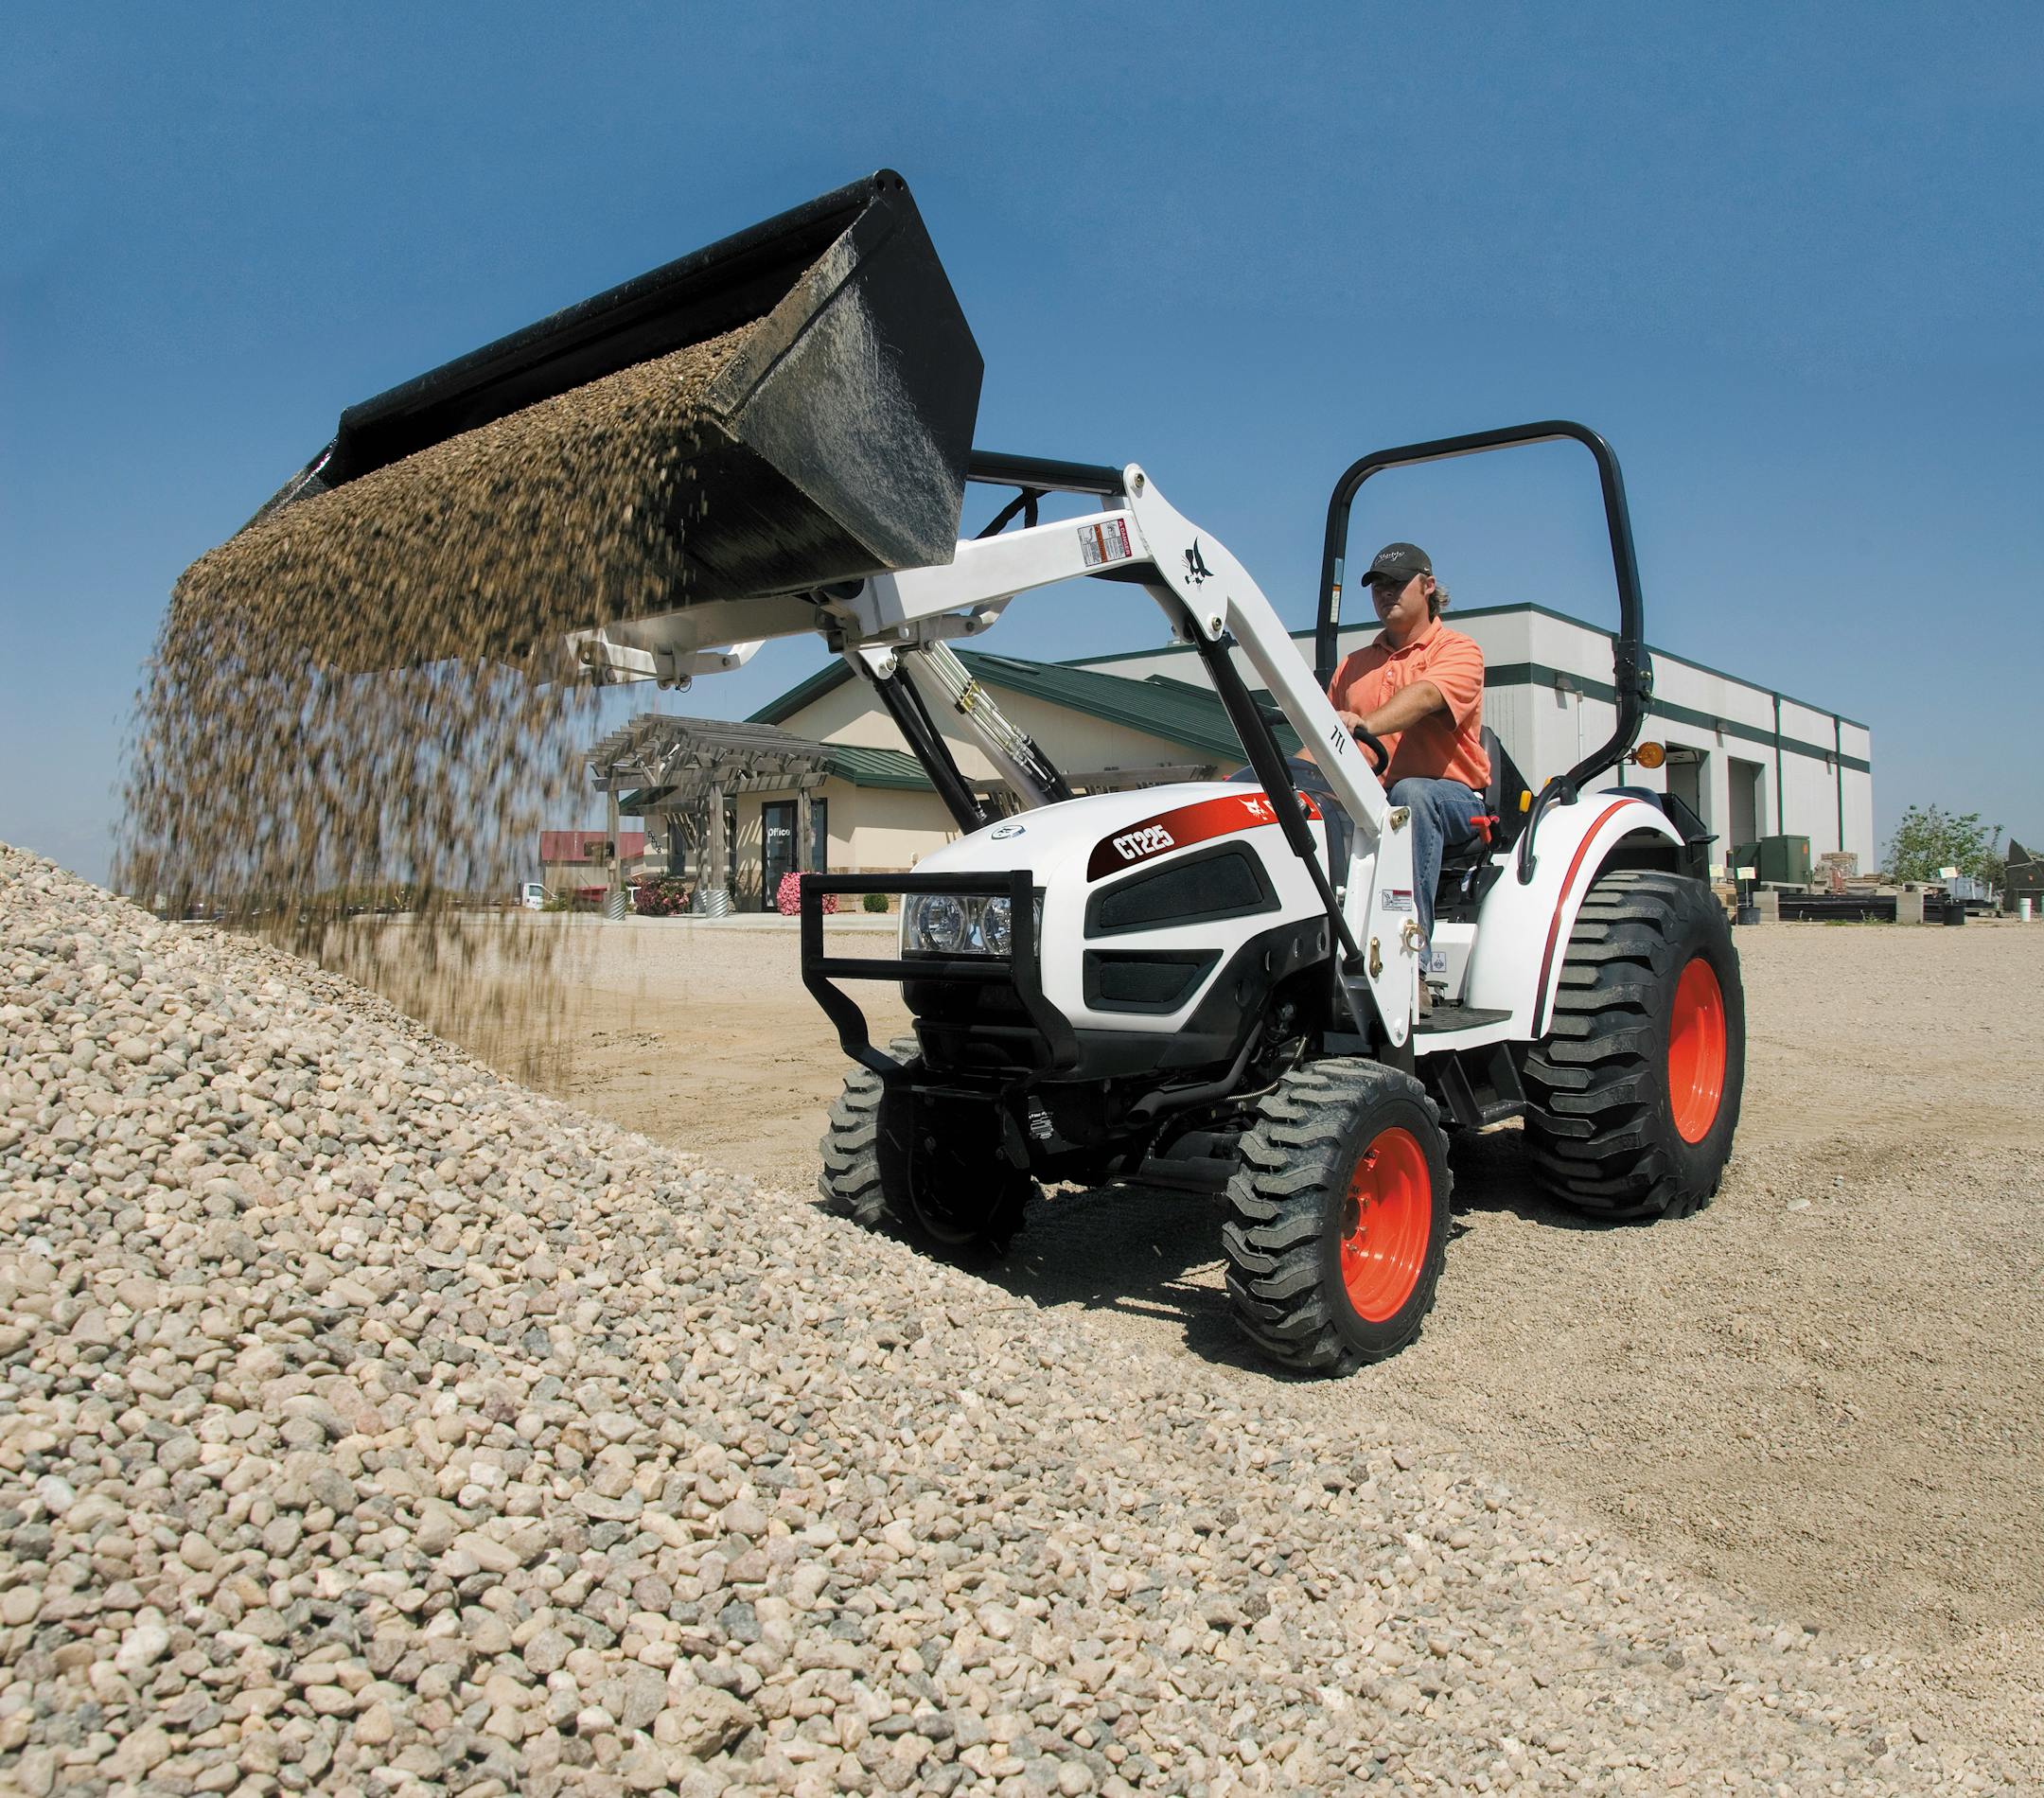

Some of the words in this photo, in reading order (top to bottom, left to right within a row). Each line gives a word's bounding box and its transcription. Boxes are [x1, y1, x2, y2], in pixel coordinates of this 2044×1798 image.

[1119, 527, 1131, 555] DANGER
[1330, 725, 1346, 755] 7TL
[768, 827, 791, 837] Office
[1112, 824, 1174, 859] CT225
